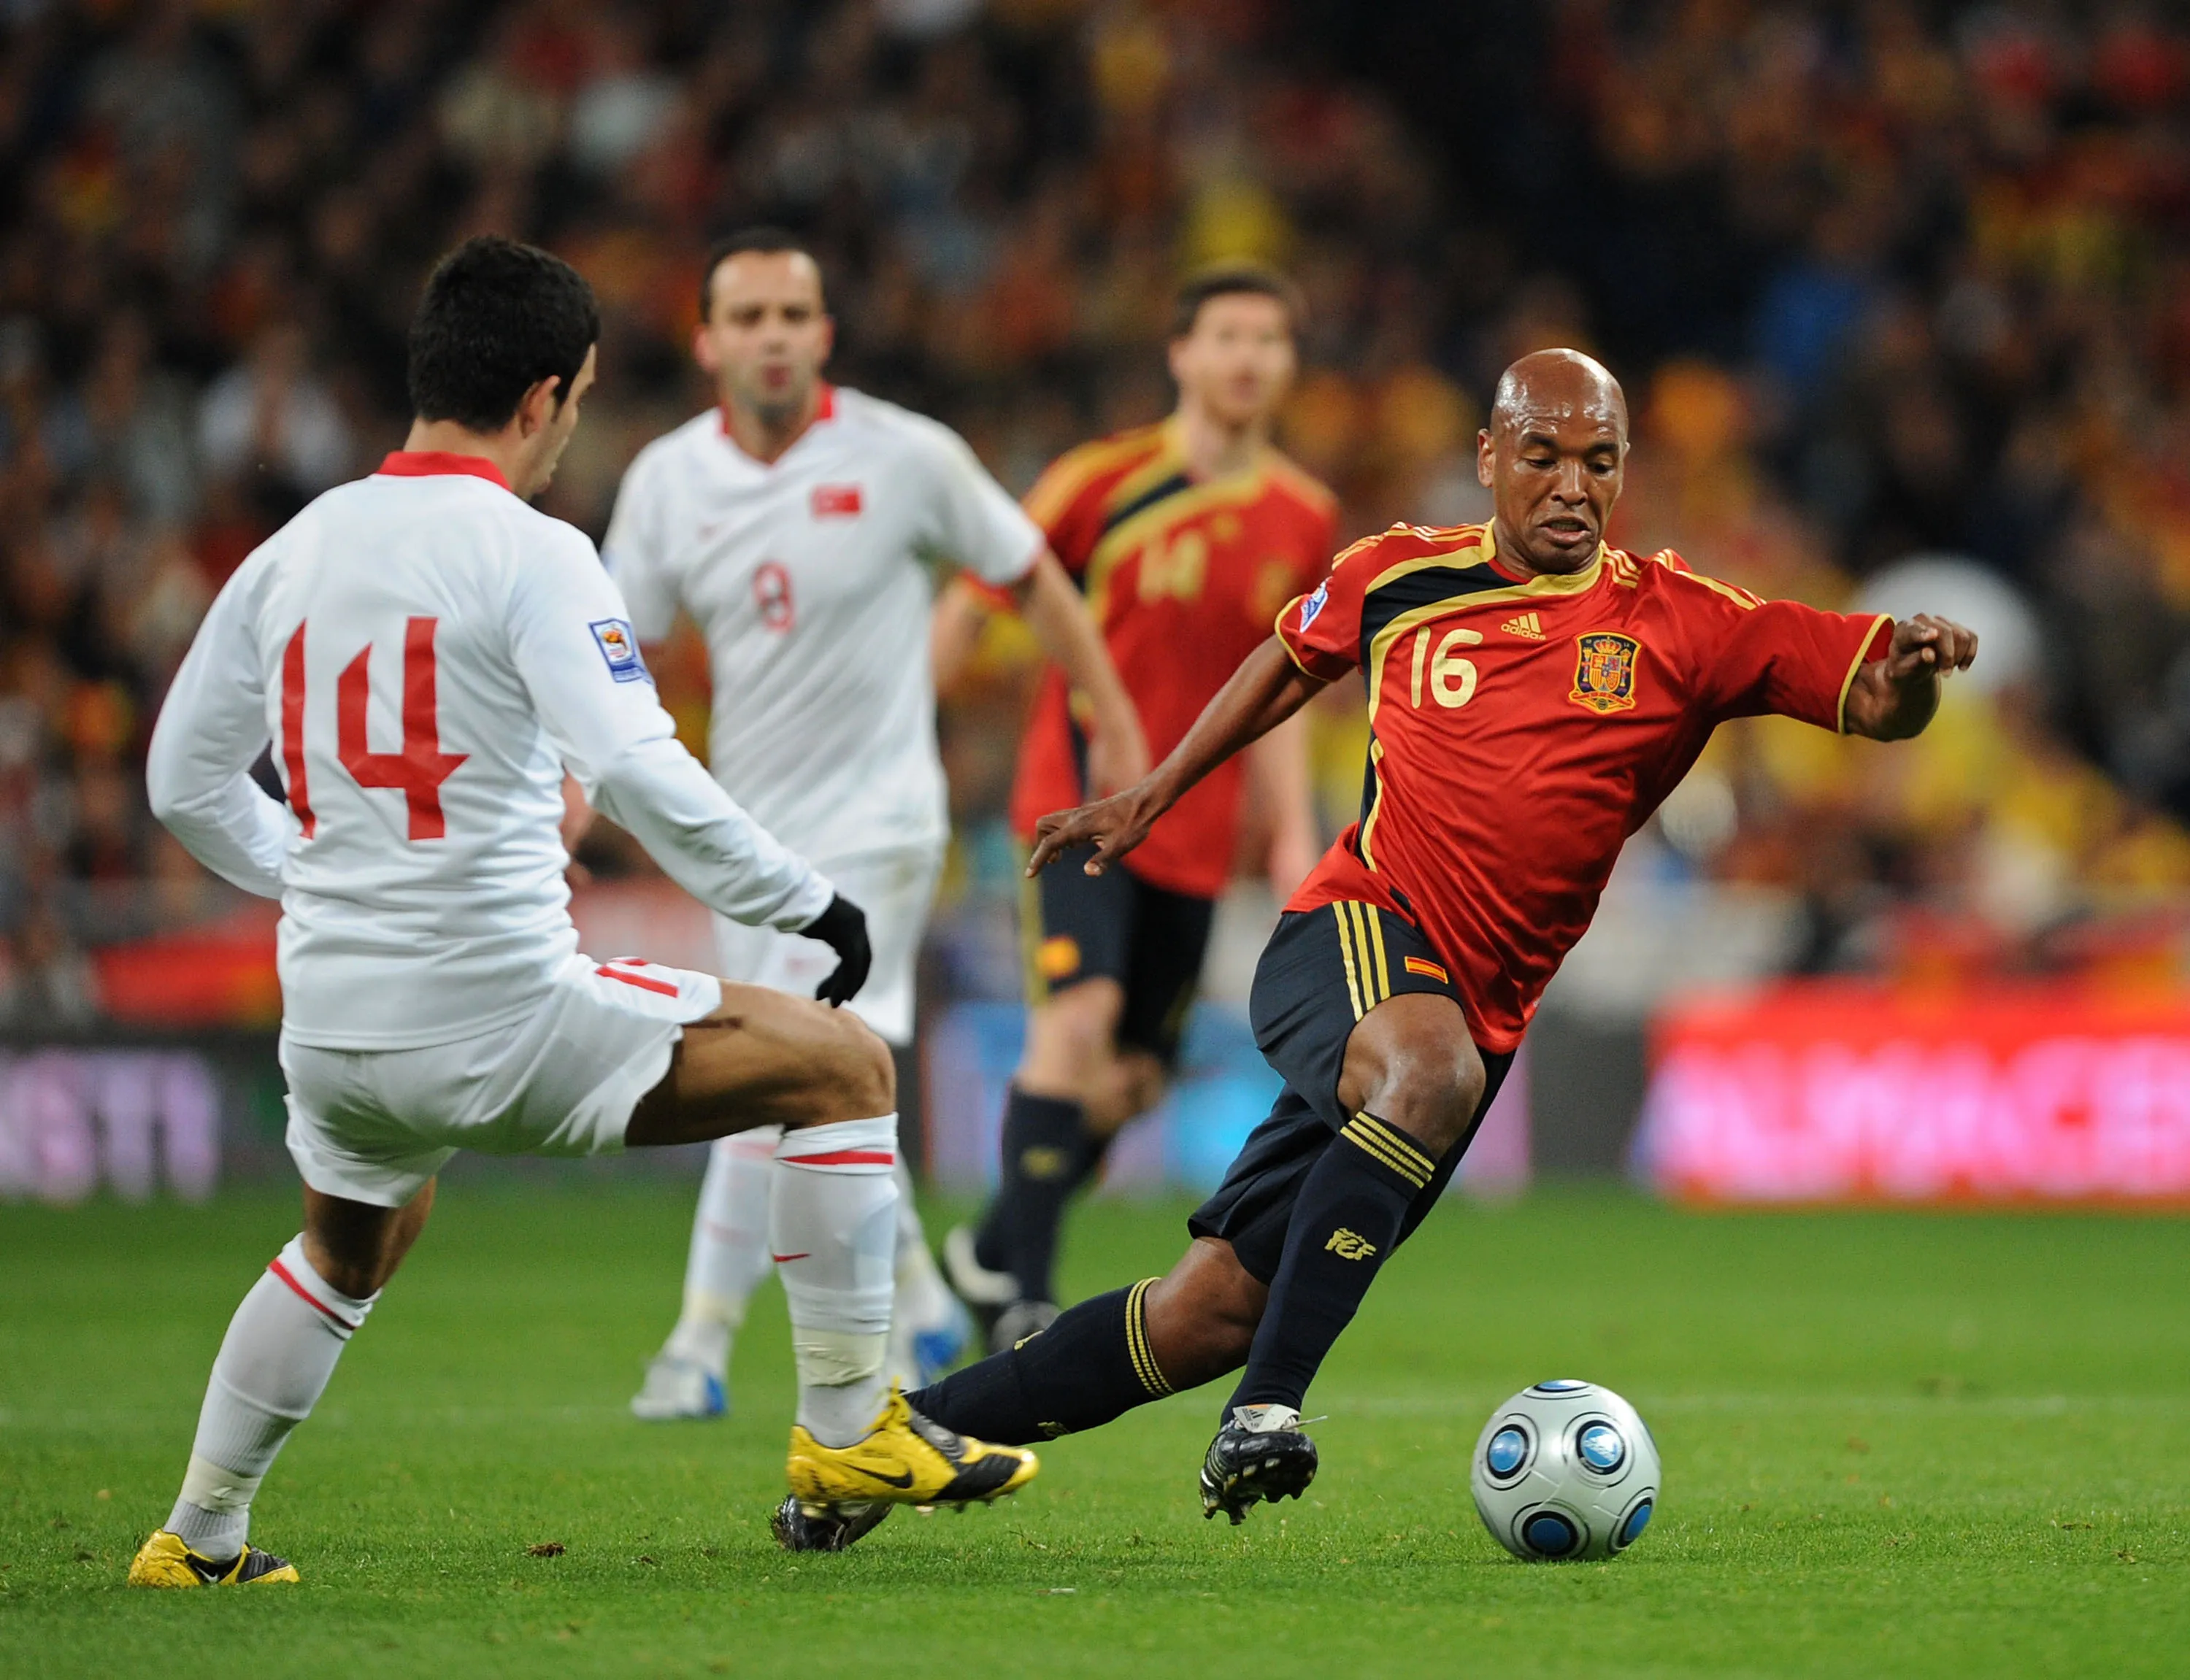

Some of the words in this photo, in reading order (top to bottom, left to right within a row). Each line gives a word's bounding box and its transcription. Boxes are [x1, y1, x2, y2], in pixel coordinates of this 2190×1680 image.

[1410, 625, 1483, 709] 16
[1500, 623, 1546, 641] adidas
[282, 616, 471, 841] 14
